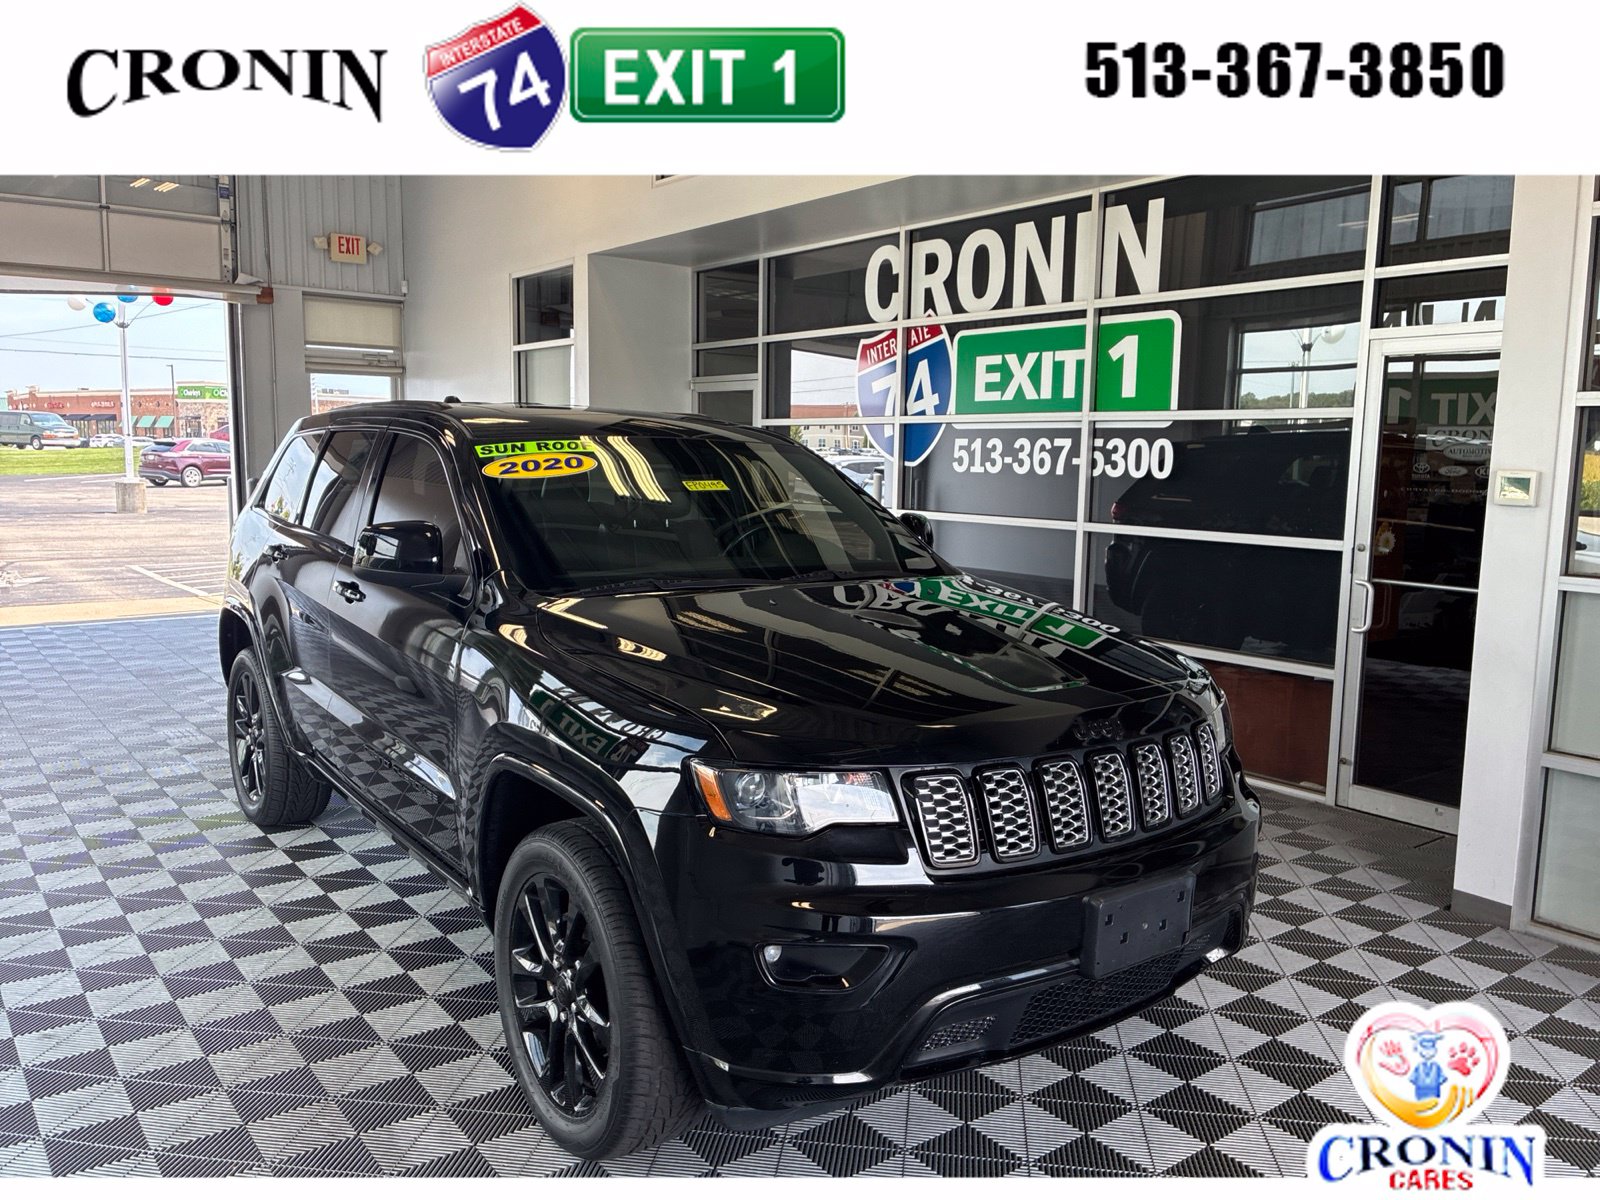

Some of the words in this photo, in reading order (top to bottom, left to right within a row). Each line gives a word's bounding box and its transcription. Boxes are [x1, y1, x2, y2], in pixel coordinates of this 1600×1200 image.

[338, 236, 361, 256] EXIT
[864, 197, 1165, 323] CRONIN
[975, 349, 1086, 402] EXIT
[1107, 334, 1139, 398] 1
[871, 359, 939, 438] 74
[480, 443, 526, 455] SUN
[536, 441, 592, 451] ROOF
[499, 456, 584, 475] 2020
